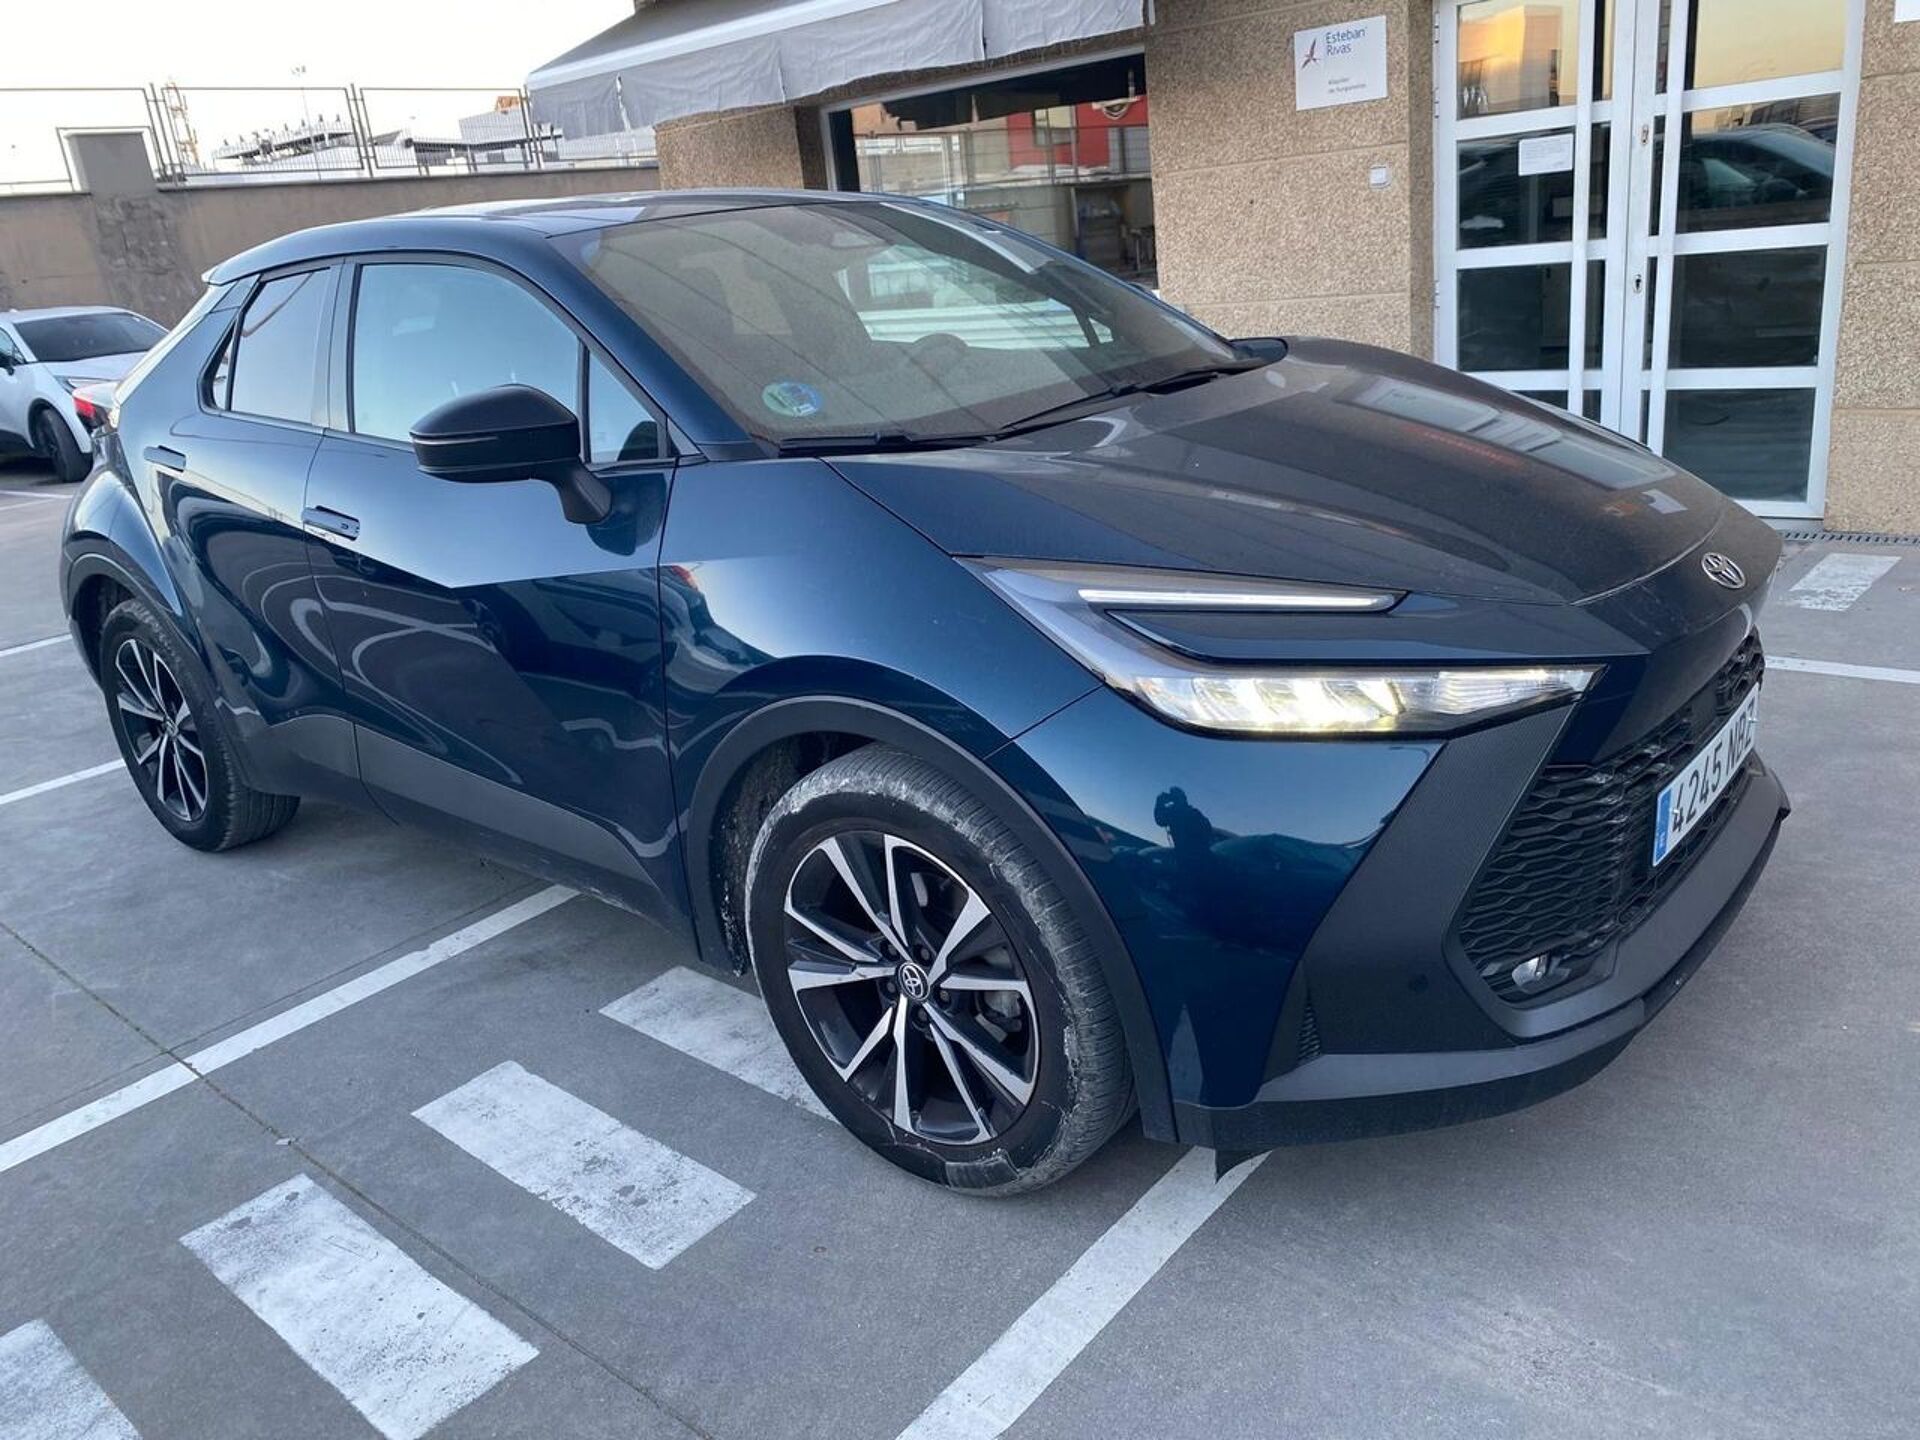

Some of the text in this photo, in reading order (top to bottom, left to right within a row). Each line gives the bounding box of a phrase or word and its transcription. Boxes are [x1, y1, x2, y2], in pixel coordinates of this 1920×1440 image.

[1325, 28, 1366, 44] Esteban
[1326, 43, 1352, 56] Rivas
[1672, 740, 1723, 832] 4245
